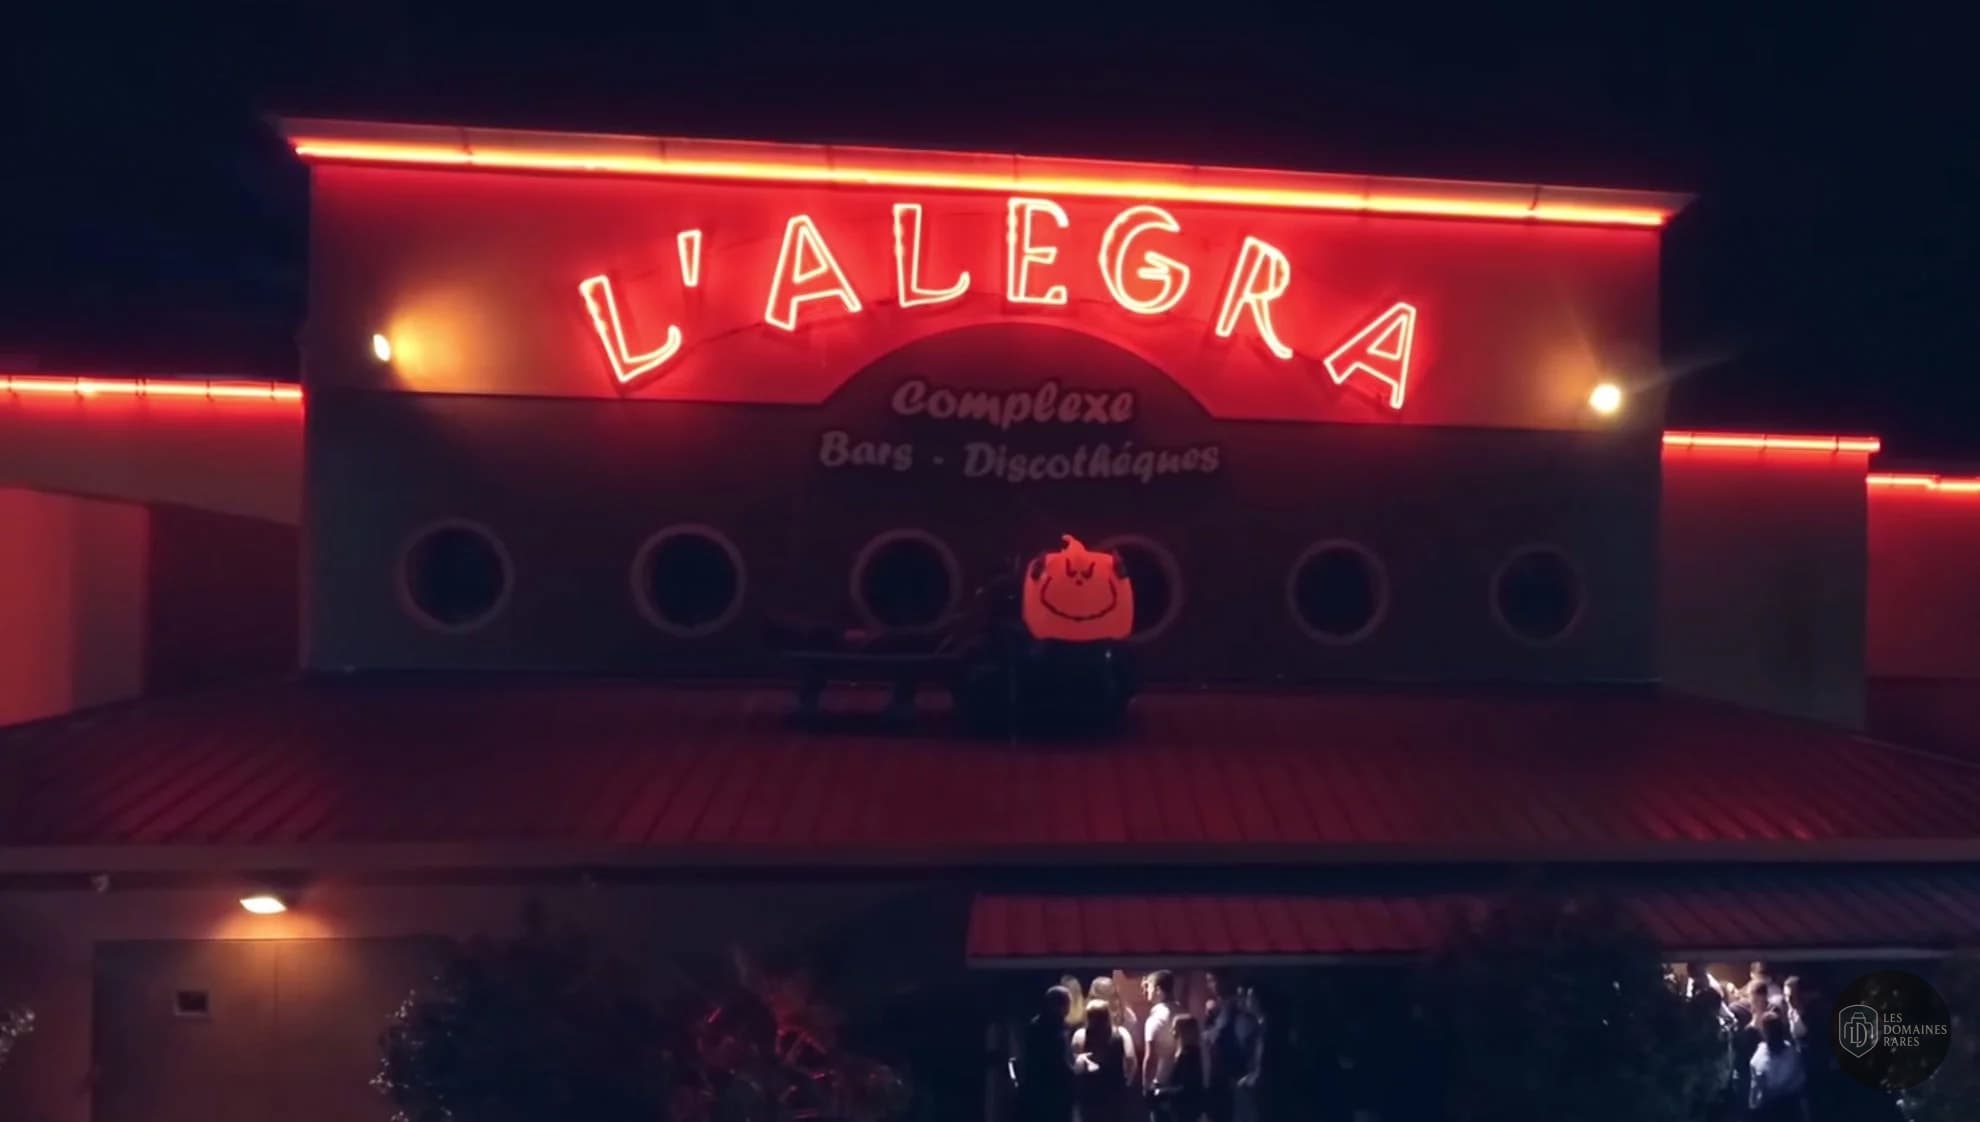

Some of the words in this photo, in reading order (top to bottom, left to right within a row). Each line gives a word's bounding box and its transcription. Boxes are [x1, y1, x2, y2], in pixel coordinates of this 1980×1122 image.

[578, 196, 1418, 411] L'ALEGRA
[891, 380, 1135, 430] Complexe
[818, 430, 914, 472] Bars
